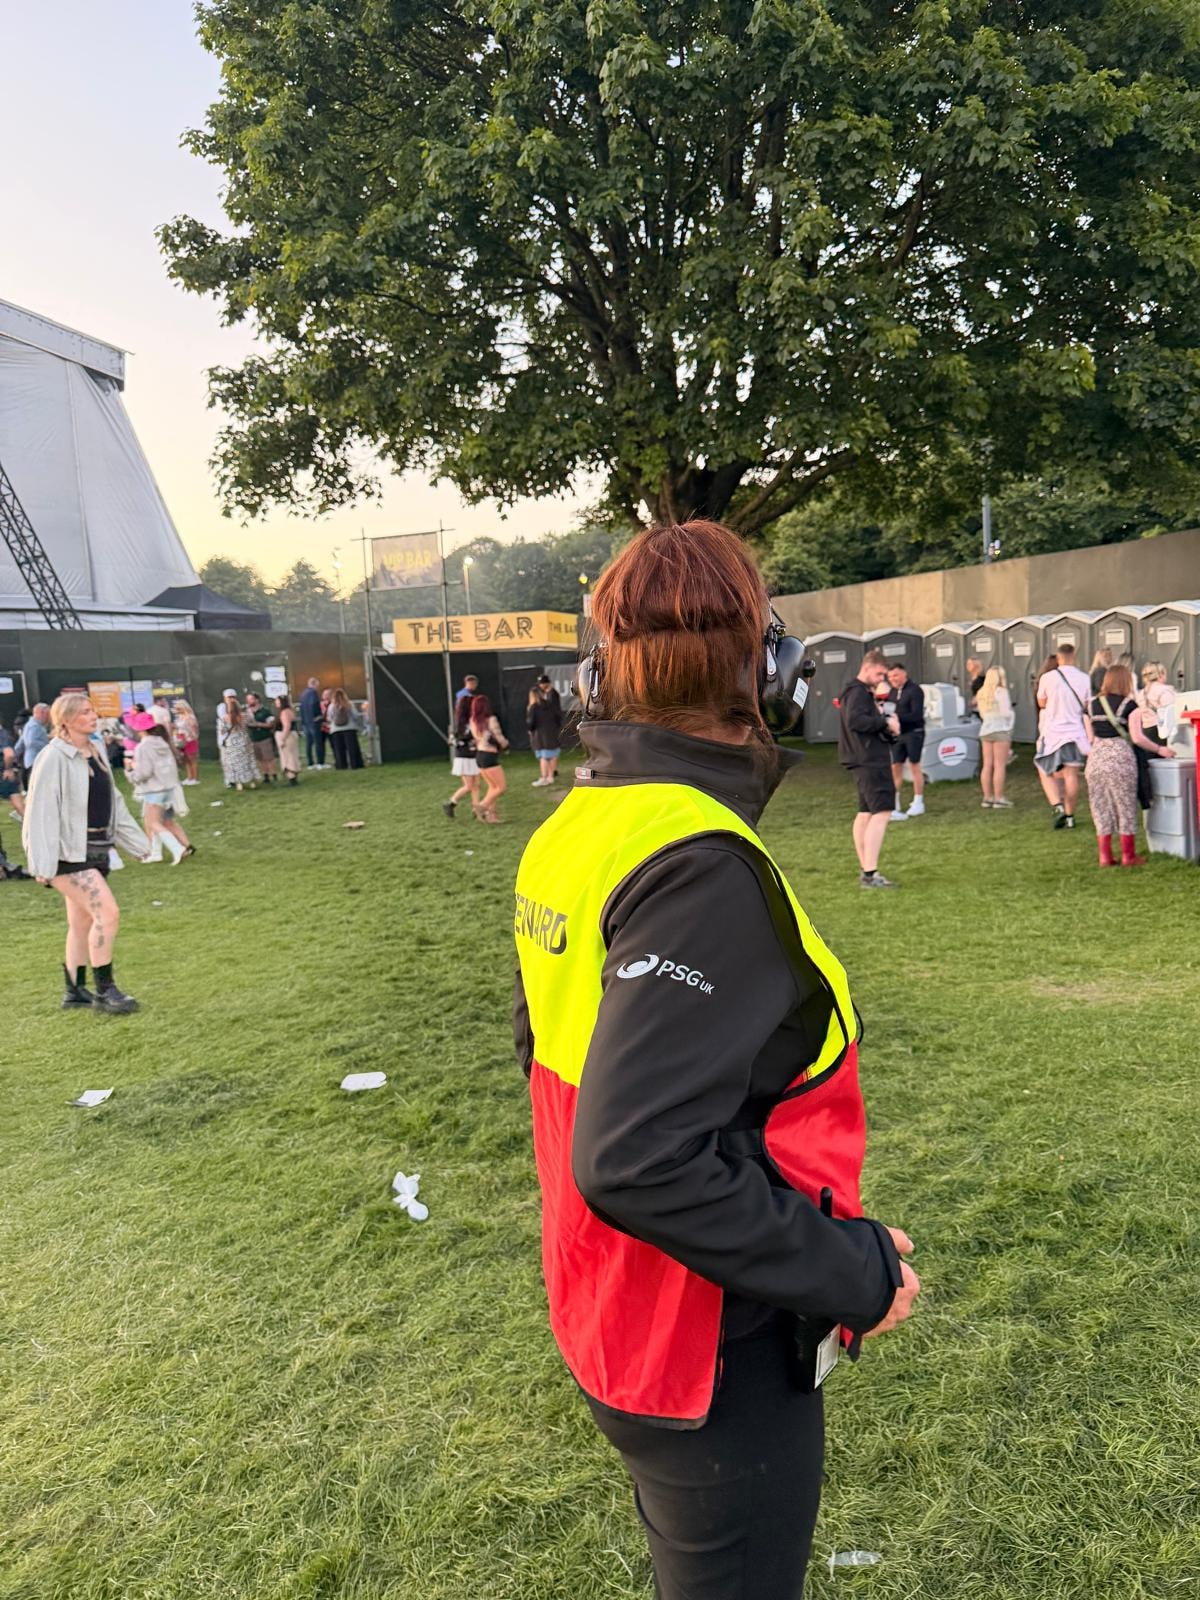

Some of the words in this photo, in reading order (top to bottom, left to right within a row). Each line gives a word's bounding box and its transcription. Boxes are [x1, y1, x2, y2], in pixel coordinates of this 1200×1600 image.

[404, 548, 432, 568] BAR
[408, 620, 462, 645] THE
[474, 616, 533, 642] BAR
[516, 892, 568, 955] EWARD
[656, 960, 704, 987] PSG
[699, 980, 715, 995] UK
